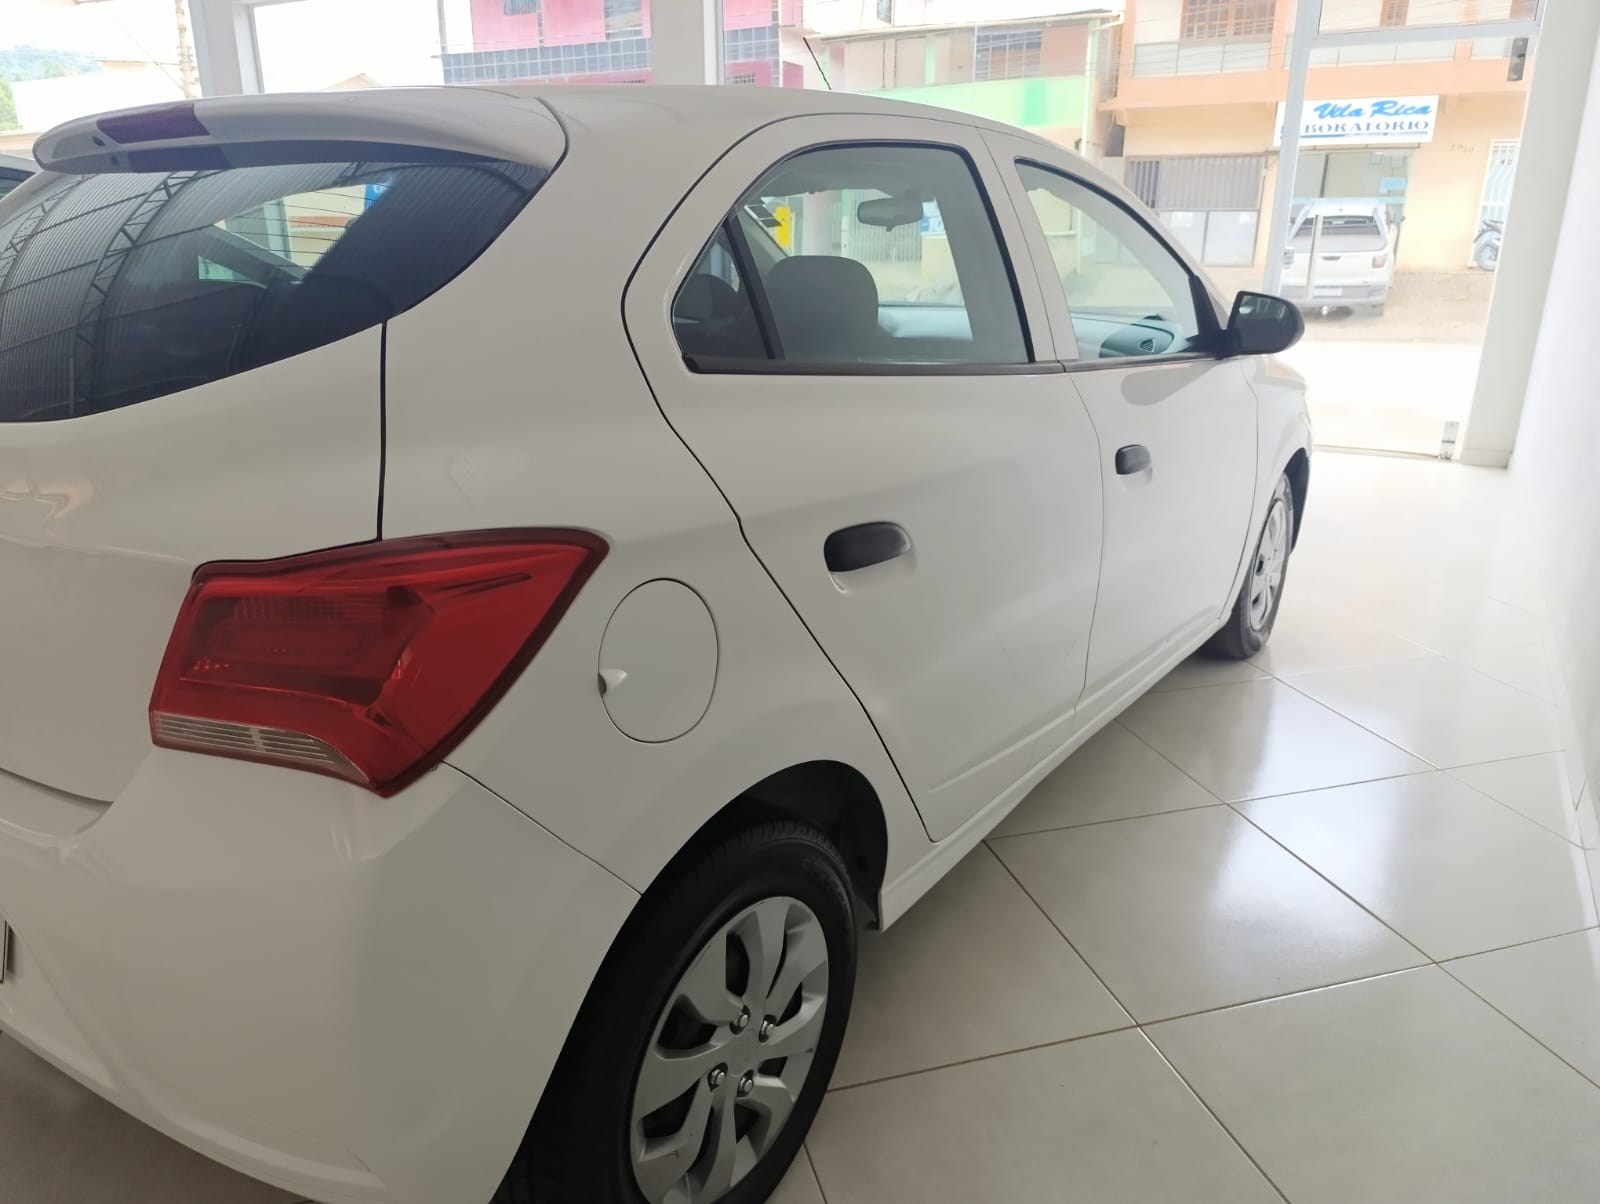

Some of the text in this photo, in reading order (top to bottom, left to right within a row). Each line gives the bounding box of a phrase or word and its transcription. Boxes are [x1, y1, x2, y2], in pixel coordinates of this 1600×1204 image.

[1313, 100, 1432, 119] Vila Rica
[1304, 120, 1429, 133] BORATORIO
